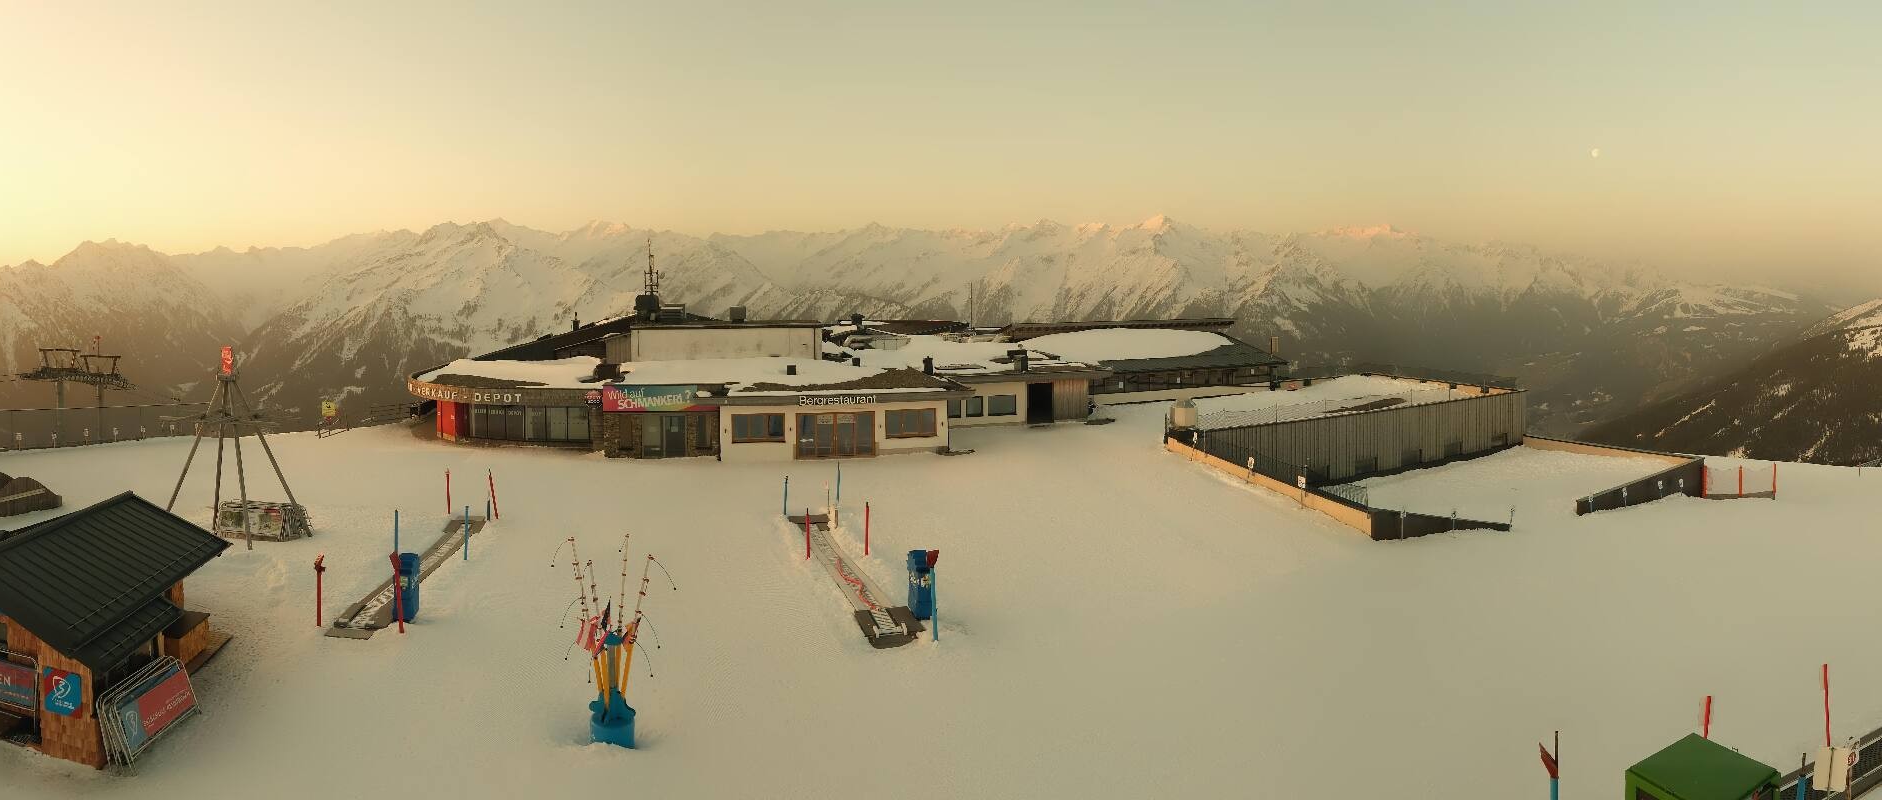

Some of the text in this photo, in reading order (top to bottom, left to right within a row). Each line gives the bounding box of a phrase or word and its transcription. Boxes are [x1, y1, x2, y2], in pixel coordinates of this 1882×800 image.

[417, 386, 457, 400] VERKAUF
[474, 392, 522, 403] DEPOT
[607, 387, 645, 400] Wild auf
[799, 395, 877, 406] Bergrestaurant
